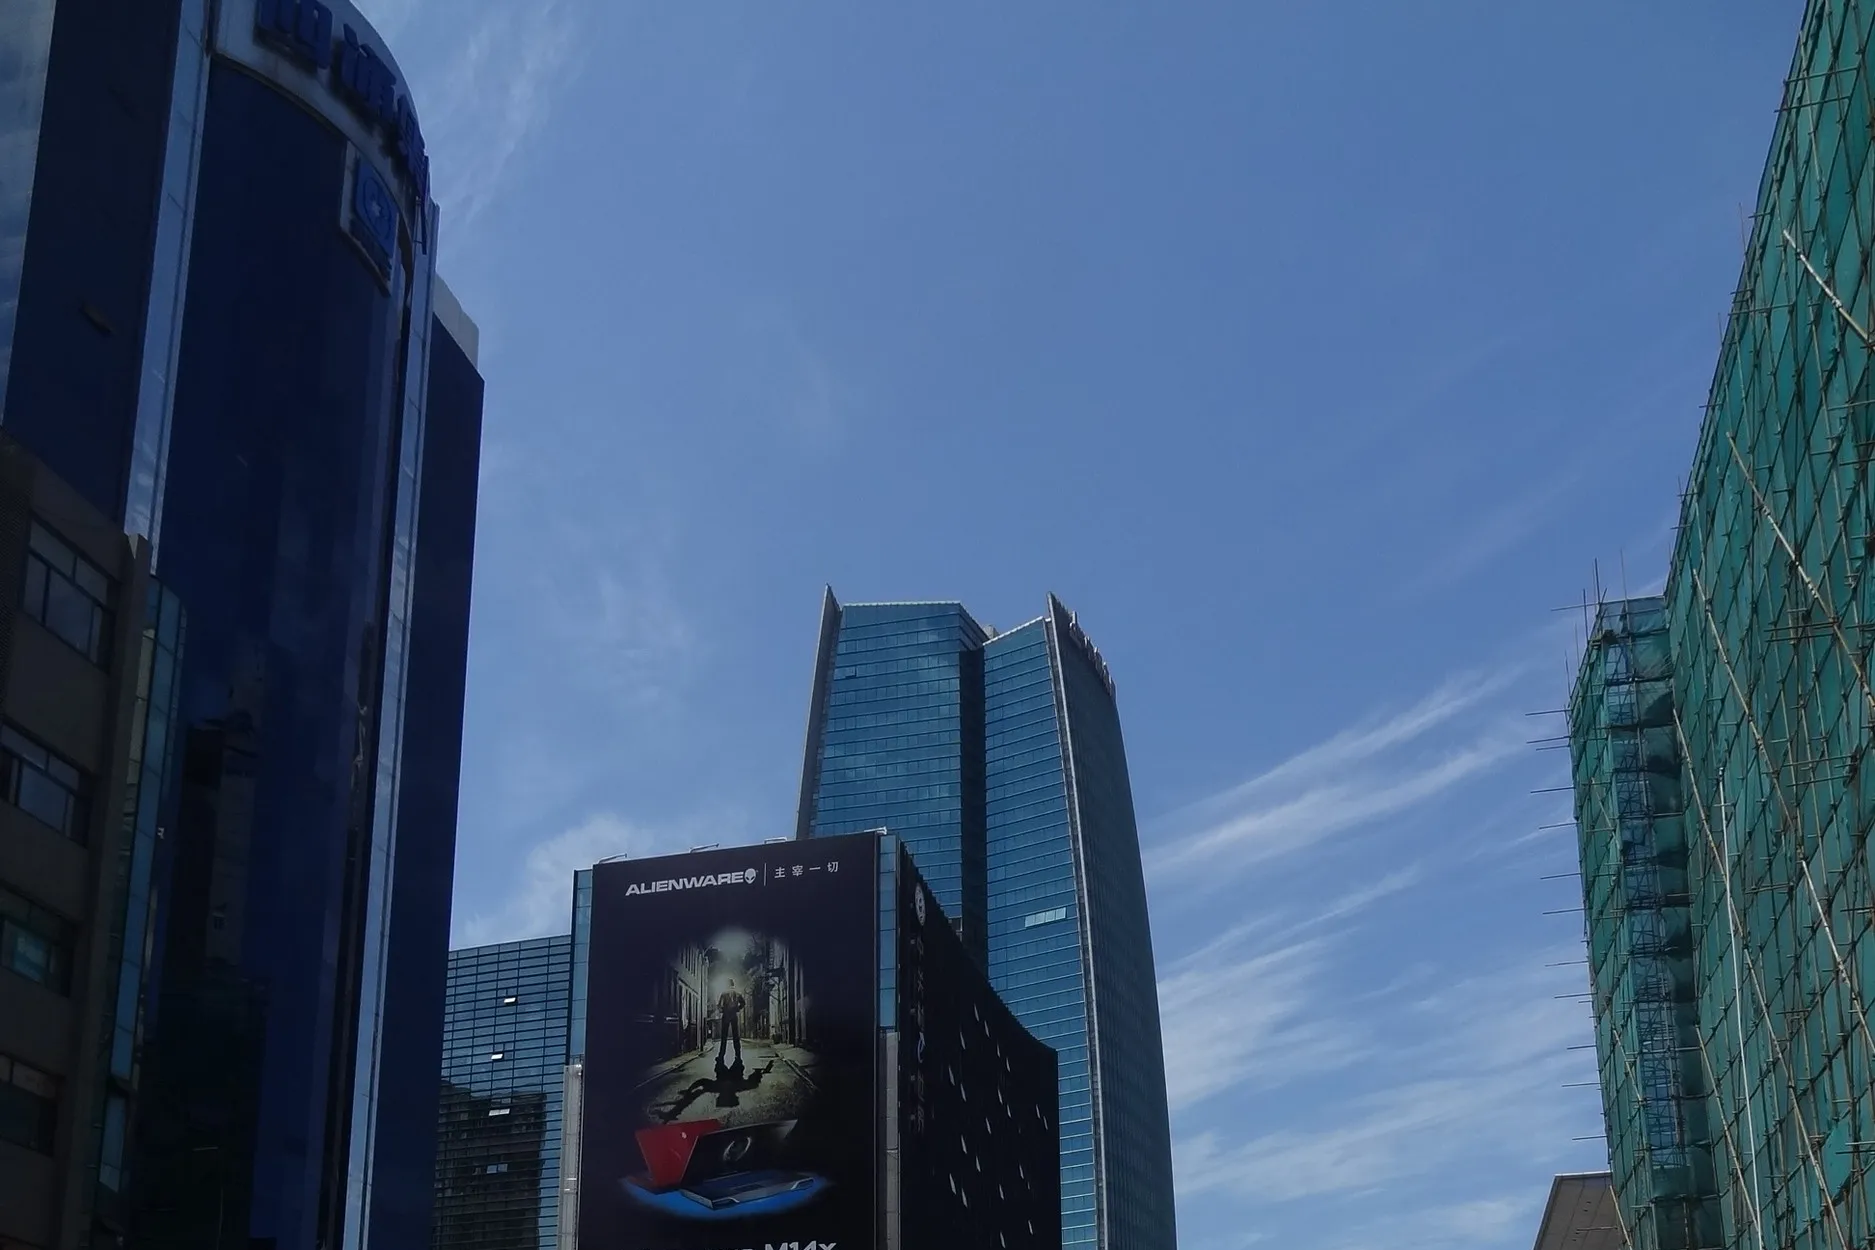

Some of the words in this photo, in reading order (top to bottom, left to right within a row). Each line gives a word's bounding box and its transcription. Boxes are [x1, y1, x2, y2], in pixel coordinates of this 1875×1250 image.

[774, 861, 839, 879] 主宰一切
[625, 871, 744, 897] ALIENWARE
